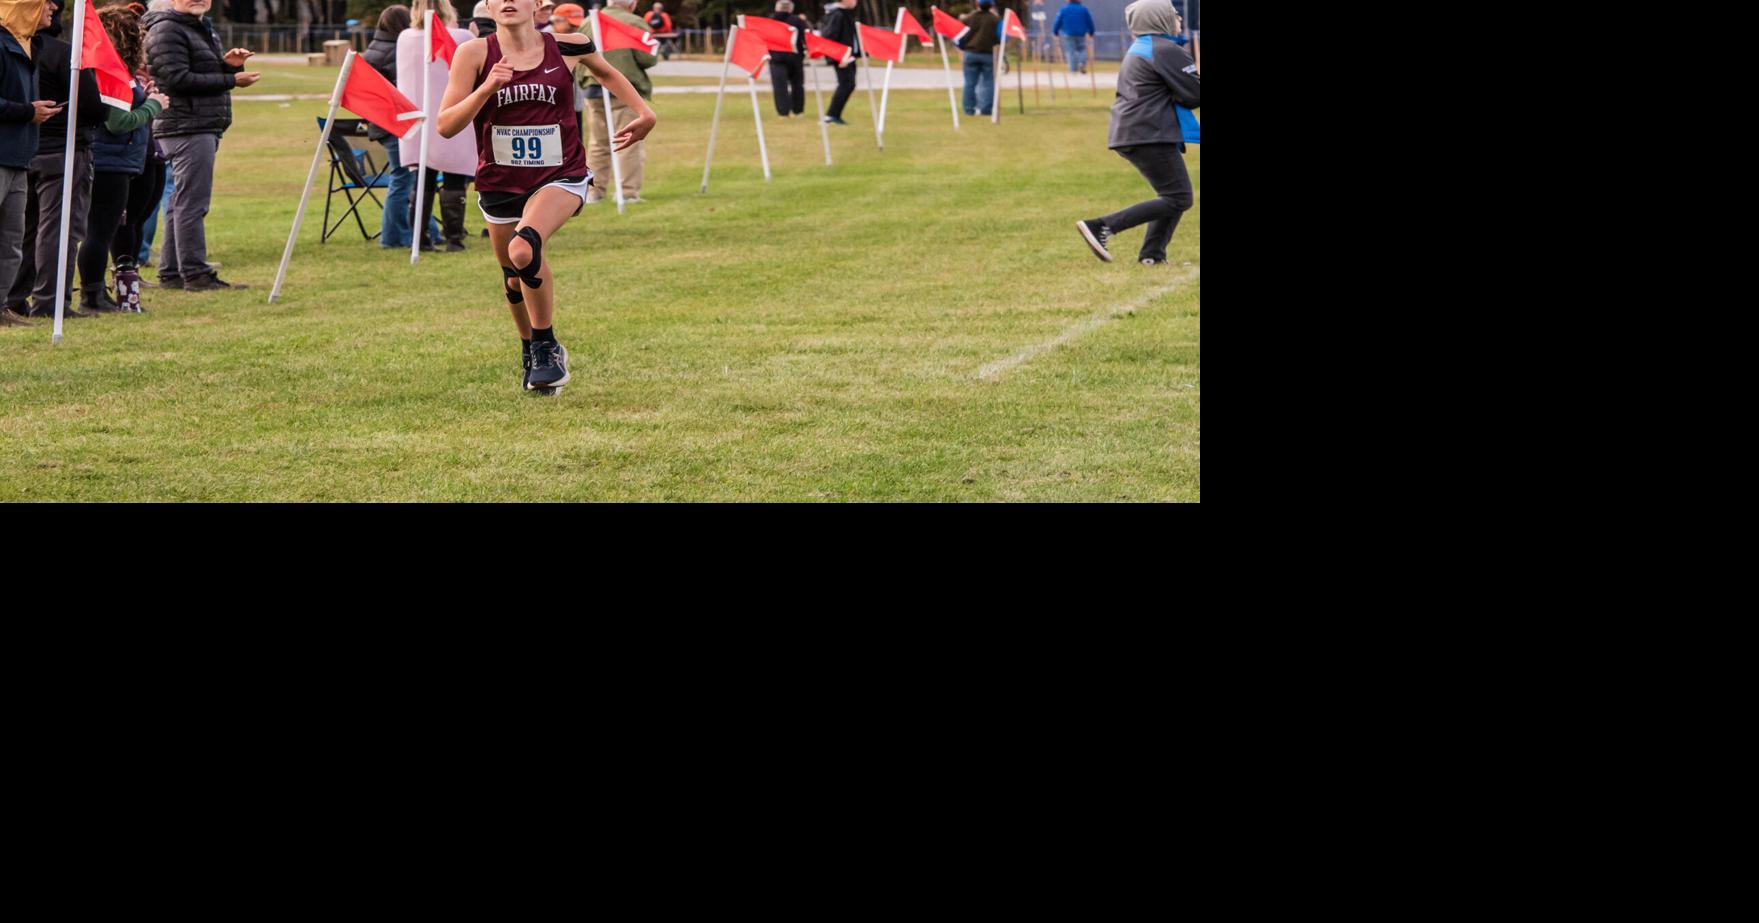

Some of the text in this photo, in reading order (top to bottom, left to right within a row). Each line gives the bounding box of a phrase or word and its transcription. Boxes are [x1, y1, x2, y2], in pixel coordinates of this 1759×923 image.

[497, 84, 557, 108] FAIRFAX
[496, 127, 555, 136] NVAC CHAMPIONSHIP
[511, 137, 542, 160] 99
